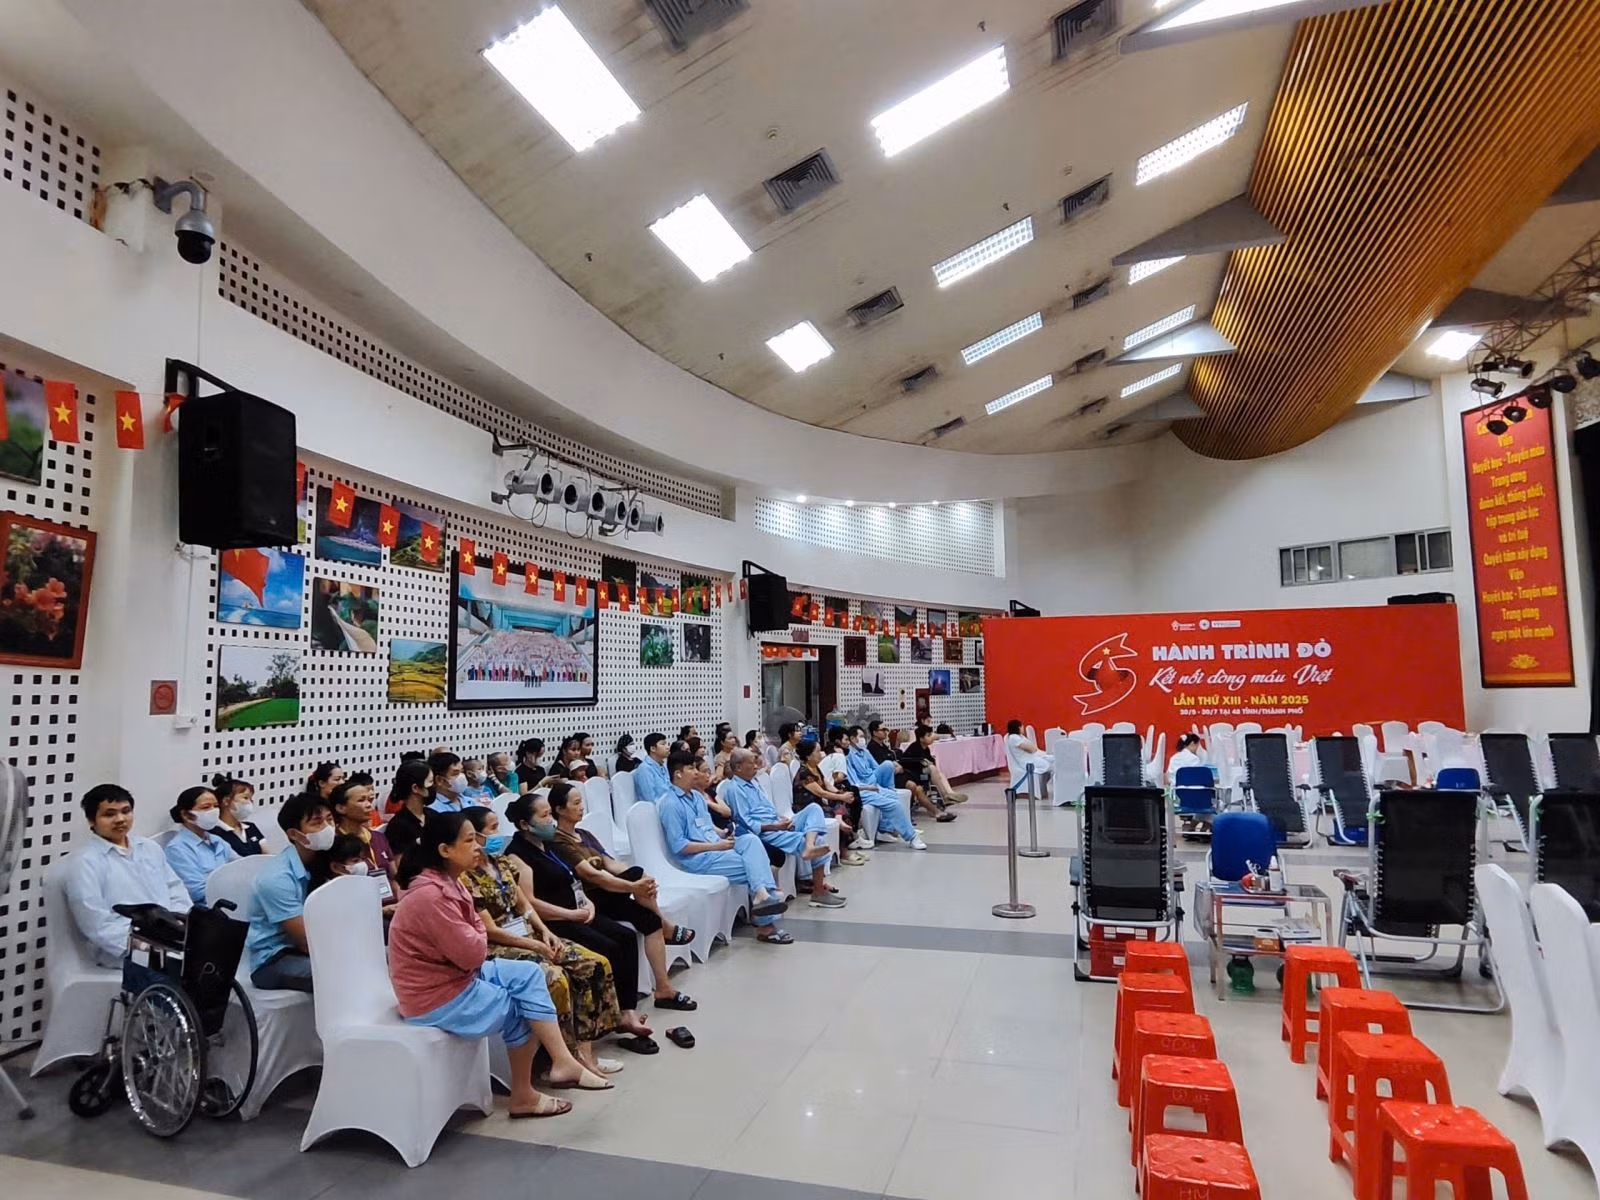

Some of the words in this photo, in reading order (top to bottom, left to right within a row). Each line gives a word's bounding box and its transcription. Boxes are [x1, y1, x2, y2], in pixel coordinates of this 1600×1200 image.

[1152, 643, 1214, 661] HÀNH
[1221, 640, 1289, 660] TRÌNH
[1297, 638, 1332, 658] ĐỎ
[1149, 666, 1178, 693] Kết
[1178, 668, 1205, 685] nối
[1207, 668, 1246, 691] dòng
[1250, 670, 1287, 683] máu
[1293, 664, 1334, 685] Việt
[1173, 693, 1195, 706] LẦN
[1198, 694, 1219, 706] THỨ
[1222, 696, 1241, 705] XIII
[1251, 694, 1278, 705] NĂM
[1281, 695, 1309, 704] 2025
